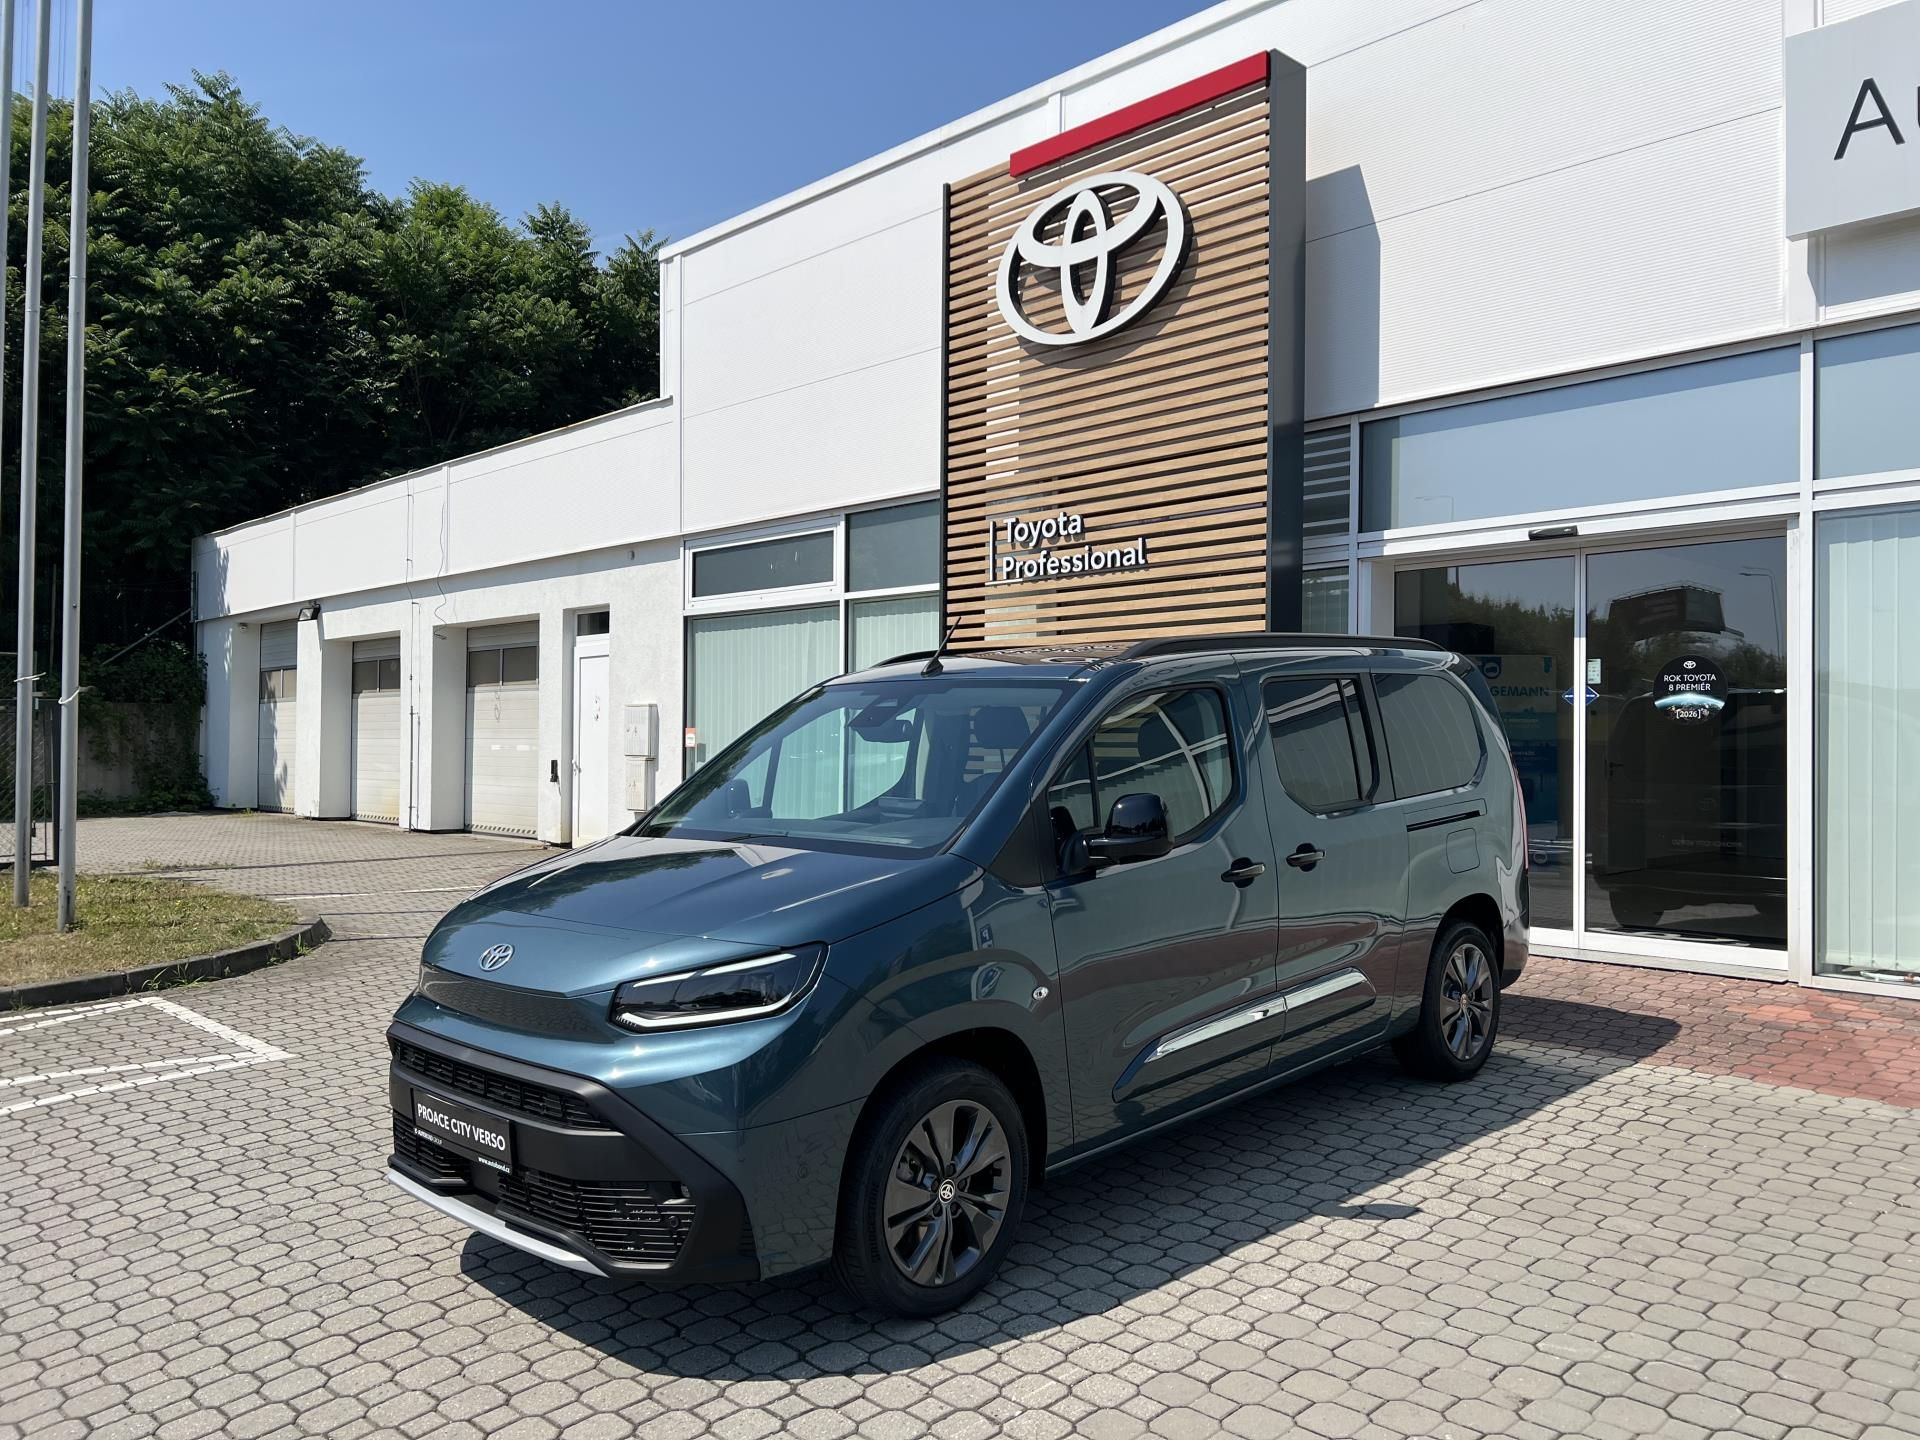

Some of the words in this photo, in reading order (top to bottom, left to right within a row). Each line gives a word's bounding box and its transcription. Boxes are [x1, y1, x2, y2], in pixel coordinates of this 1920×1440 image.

[1833, 77, 1920, 160] A
[1003, 511, 1082, 547] Toyota
[1002, 537, 1145, 580] Professional
[1663, 674, 1682, 682] ROK
[1683, 673, 1717, 682] TOYOTA
[1668, 683, 1674, 691] 8
[1675, 682, 1711, 691] PREMIÉR
[417, 1103, 450, 1131] PROACE
[450, 1118, 471, 1138] CITY
[472, 1125, 506, 1151] VERSO
